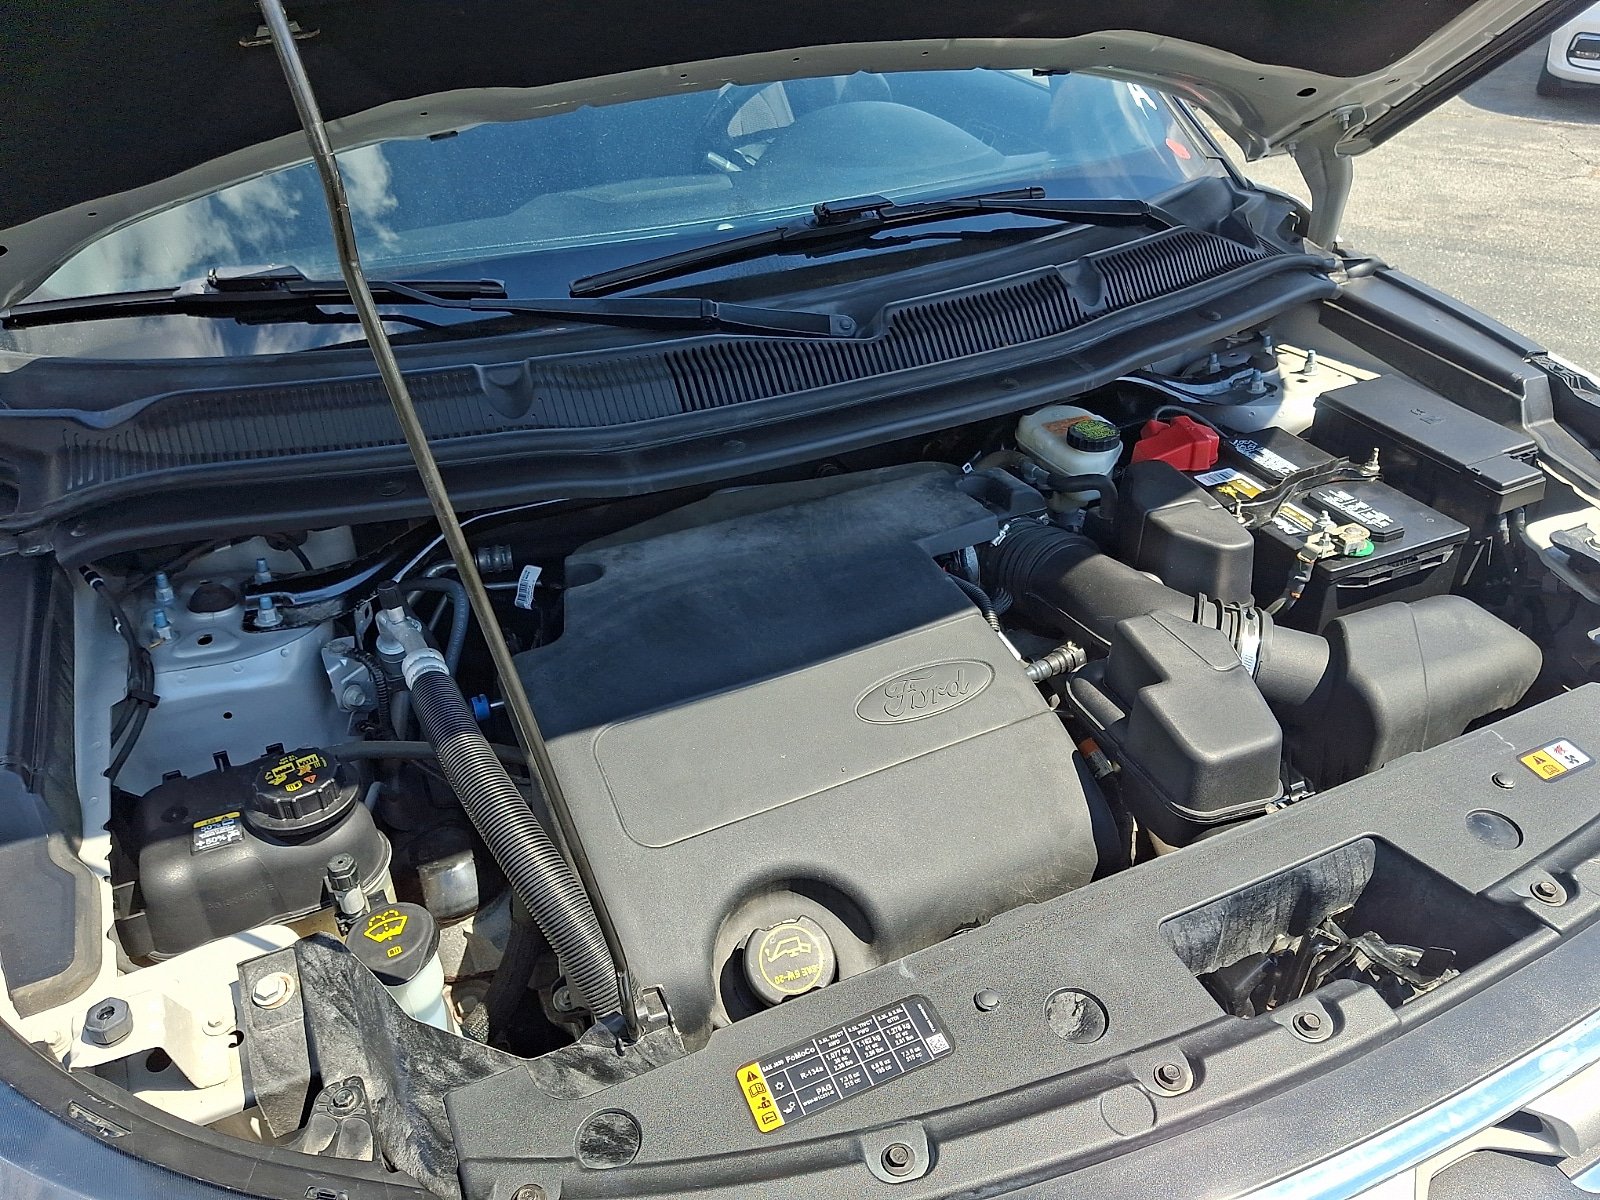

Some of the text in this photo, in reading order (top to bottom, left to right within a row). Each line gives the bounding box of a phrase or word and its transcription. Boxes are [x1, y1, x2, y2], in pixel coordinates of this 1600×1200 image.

[882, 667, 970, 718] Ford
[786, 1048, 815, 1063] FoMoCo
[826, 1050, 841, 1060] 1.077
[800, 1067, 824, 1079] R-134a
[816, 1084, 832, 1095] PAG
